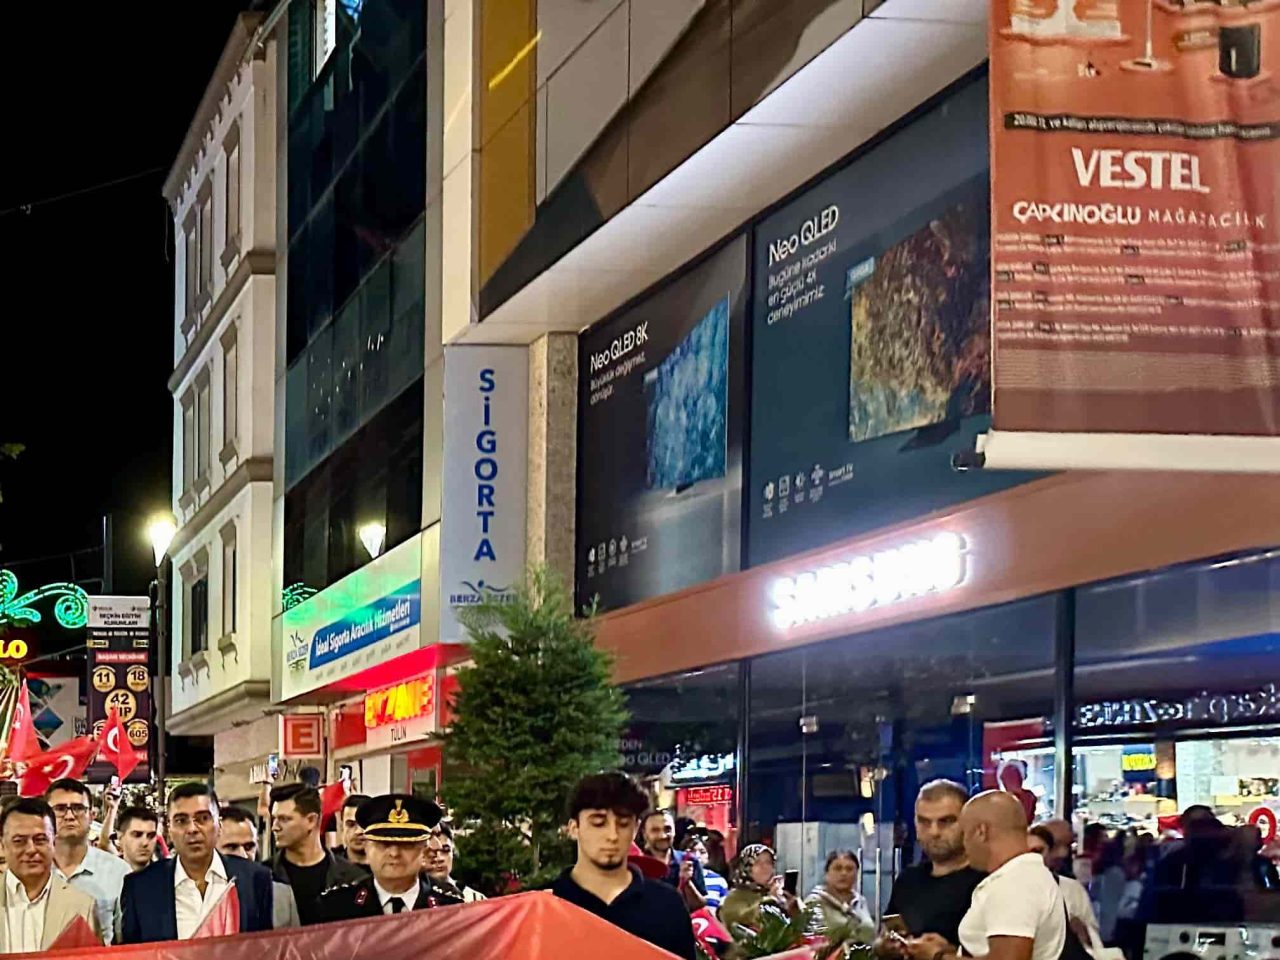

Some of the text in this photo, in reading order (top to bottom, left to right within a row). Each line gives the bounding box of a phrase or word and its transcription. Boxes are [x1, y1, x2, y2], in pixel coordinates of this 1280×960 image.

[1071, 146, 1211, 194] VESTEL
[769, 205, 839, 267] Neo QLED
[590, 320, 648, 375] Neo QLED 8K
[96, 671, 146, 683] 11 18
[110, 693, 130, 705] 42
[292, 723, 314, 749] E
